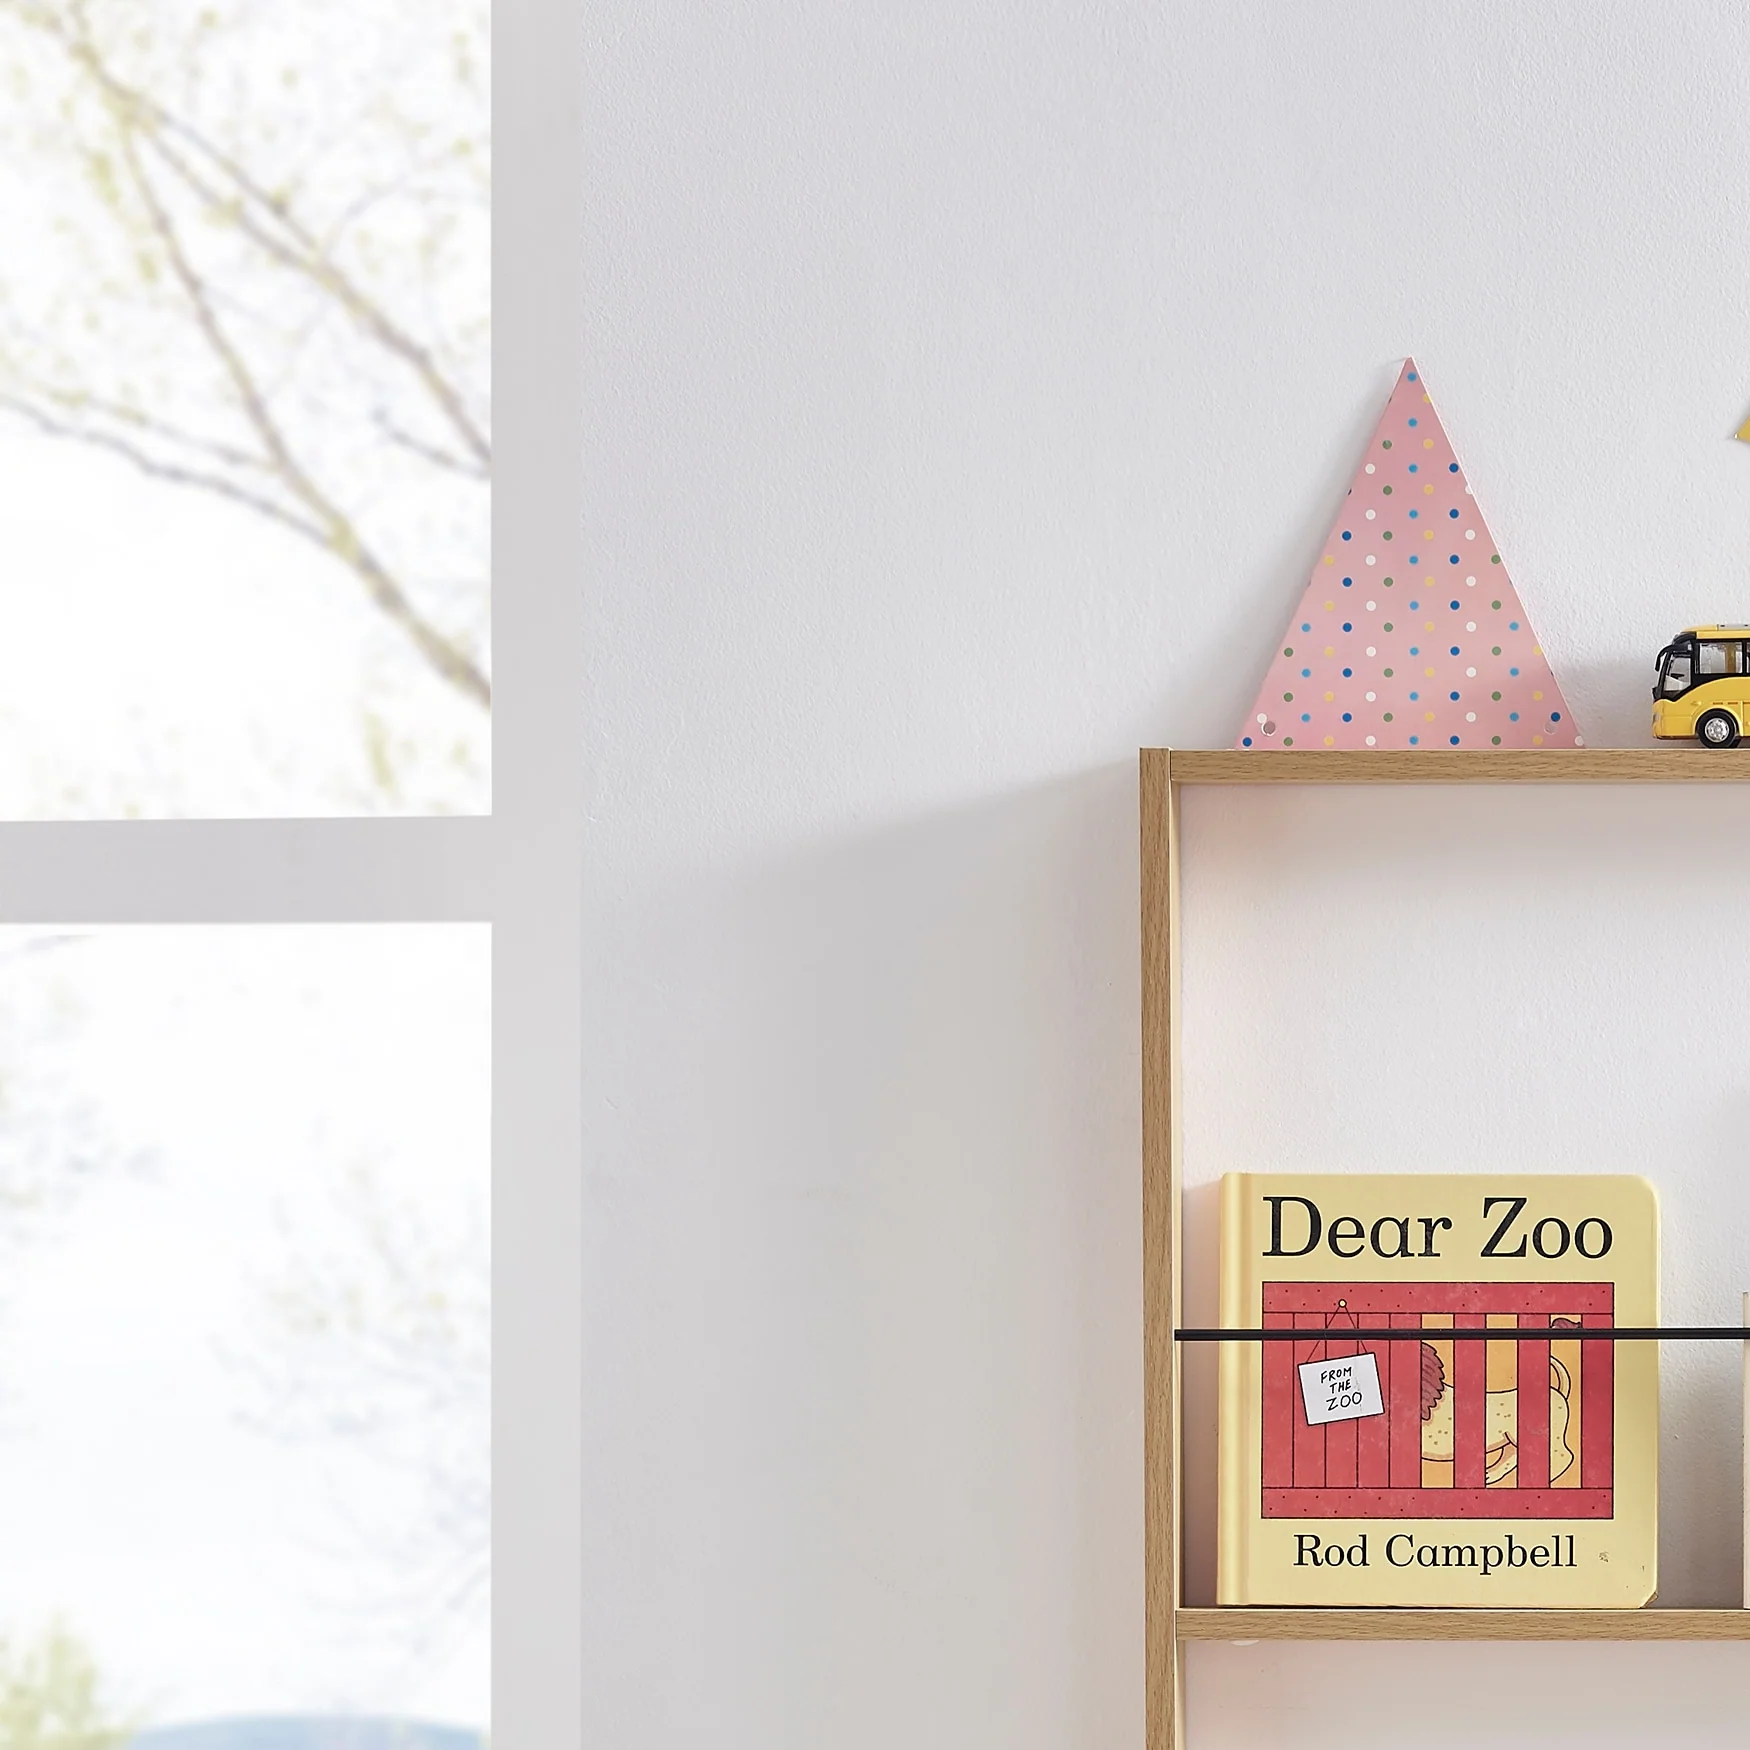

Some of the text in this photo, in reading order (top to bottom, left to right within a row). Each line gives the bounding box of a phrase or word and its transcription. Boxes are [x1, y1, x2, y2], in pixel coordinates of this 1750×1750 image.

[1261, 1196, 1614, 1260] Dear Zoo
[1320, 1366, 1352, 1384] FROM
[1329, 1379, 1352, 1394] THE
[1326, 1391, 1363, 1411] ZOO
[1292, 1534, 1578, 1576] Rod Campbell
